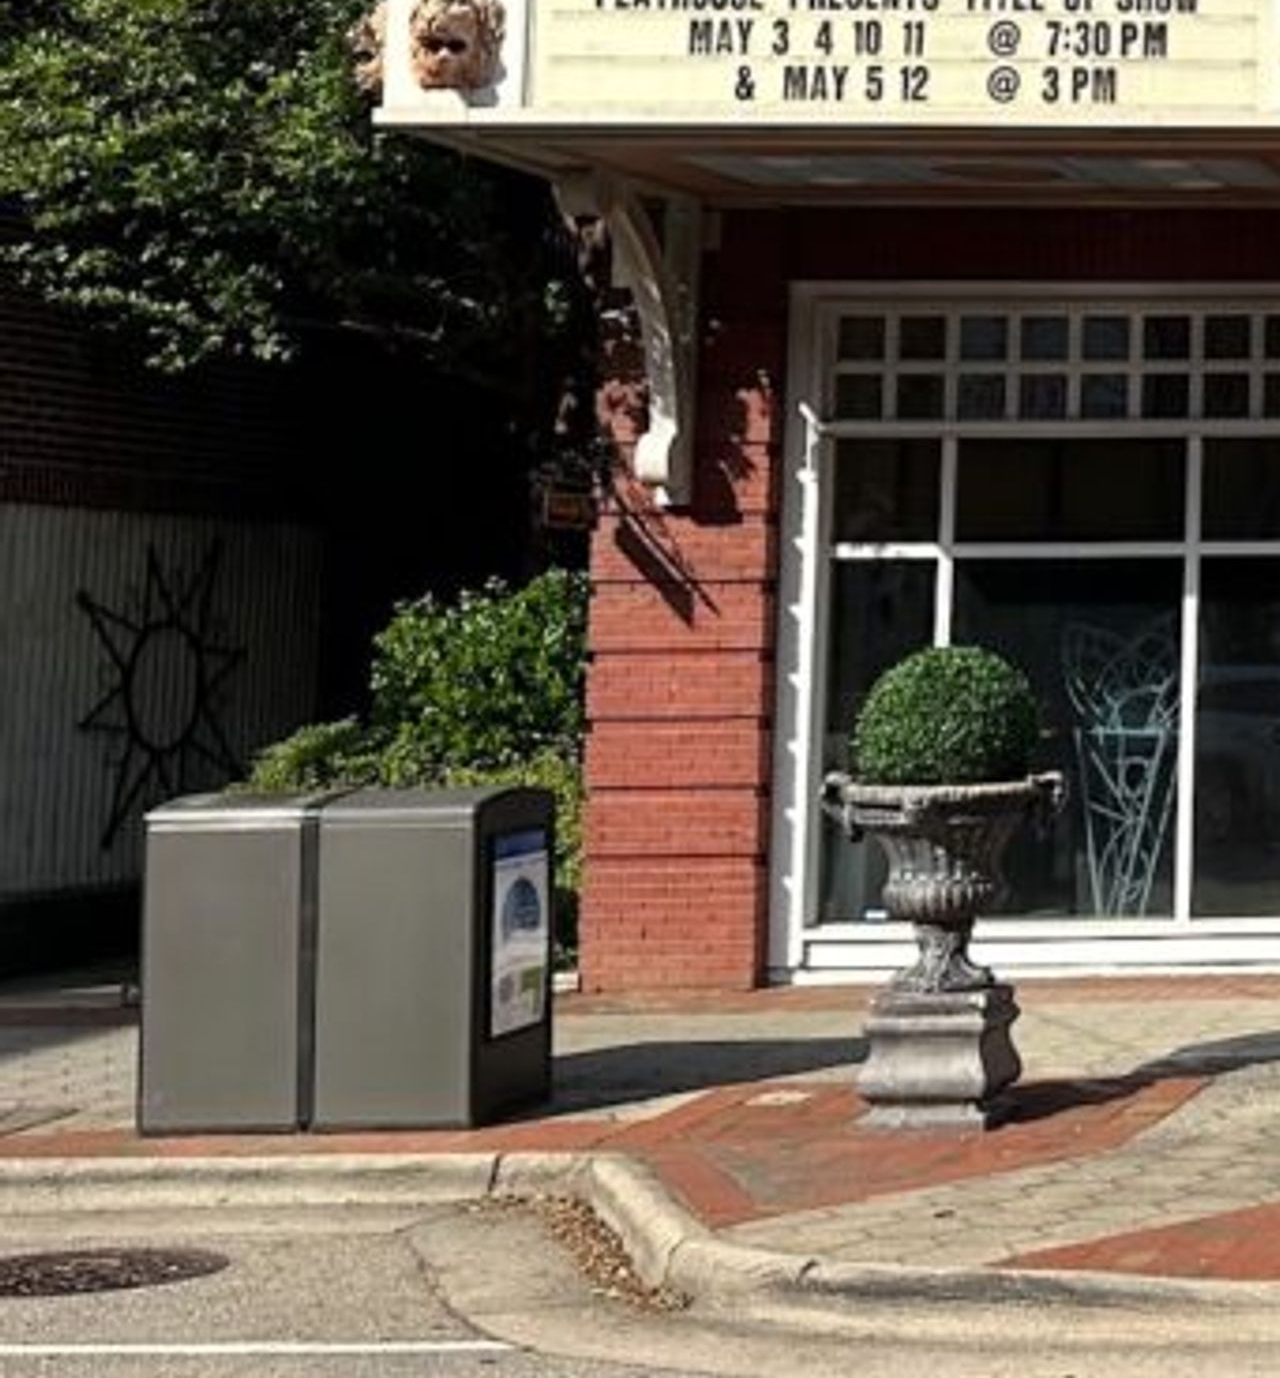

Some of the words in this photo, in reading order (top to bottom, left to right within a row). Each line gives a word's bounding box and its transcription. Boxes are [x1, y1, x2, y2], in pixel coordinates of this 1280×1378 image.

[689, 19, 754, 55] MAY
[772, 18, 789, 56] 3
[814, 20, 833, 56] 4
[853, 19, 882, 56] 10
[903, 20, 925, 56] 11
[987, 20, 1022, 57] @
[1046, 20, 1111, 58] 7:30
[1120, 21, 1168, 58] PM
[734, 65, 755, 101] &
[783, 65, 849, 102] MAY
[865, 65, 883, 102] 5
[900, 65, 929, 102] 12
[986, 65, 1021, 104] @
[1041, 66, 1060, 104] 3
[1071, 66, 1117, 104] PM
